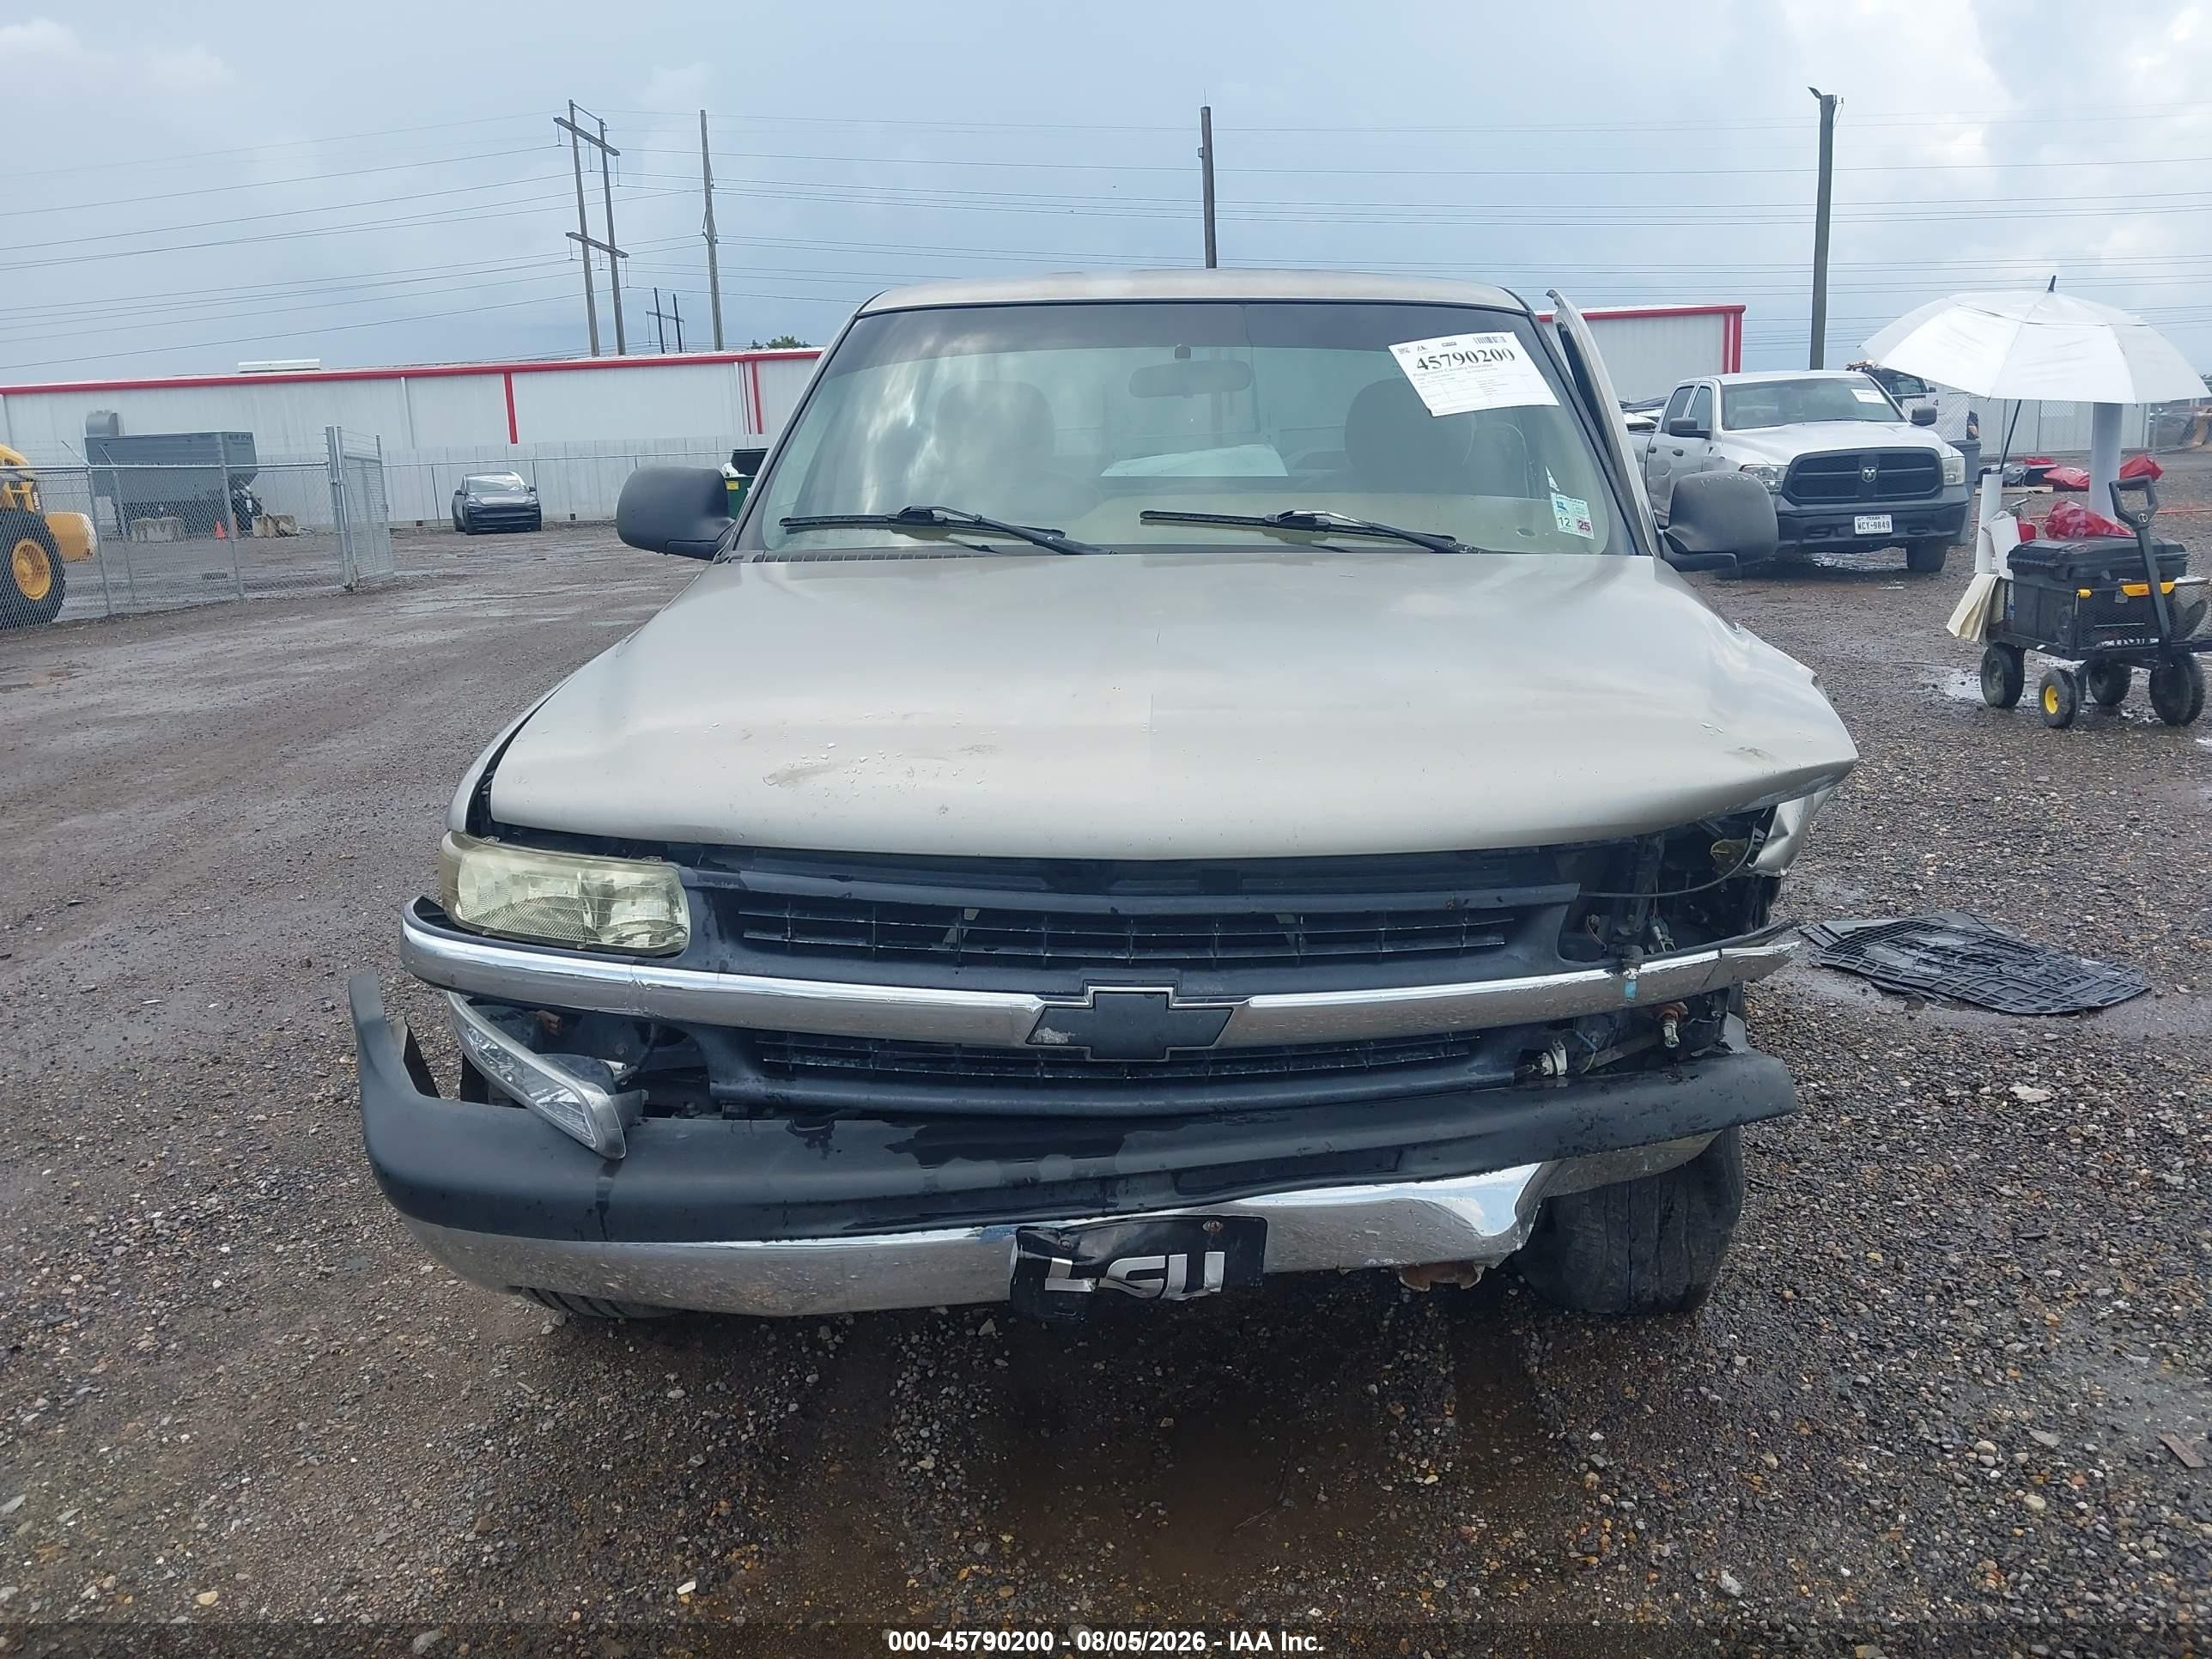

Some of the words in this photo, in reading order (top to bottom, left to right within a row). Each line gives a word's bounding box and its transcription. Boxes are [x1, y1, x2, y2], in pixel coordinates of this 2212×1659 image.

[1417, 348, 1515, 369] 45790200
[1559, 517, 1571, 527] 12
[1577, 520, 1590, 532] 25
